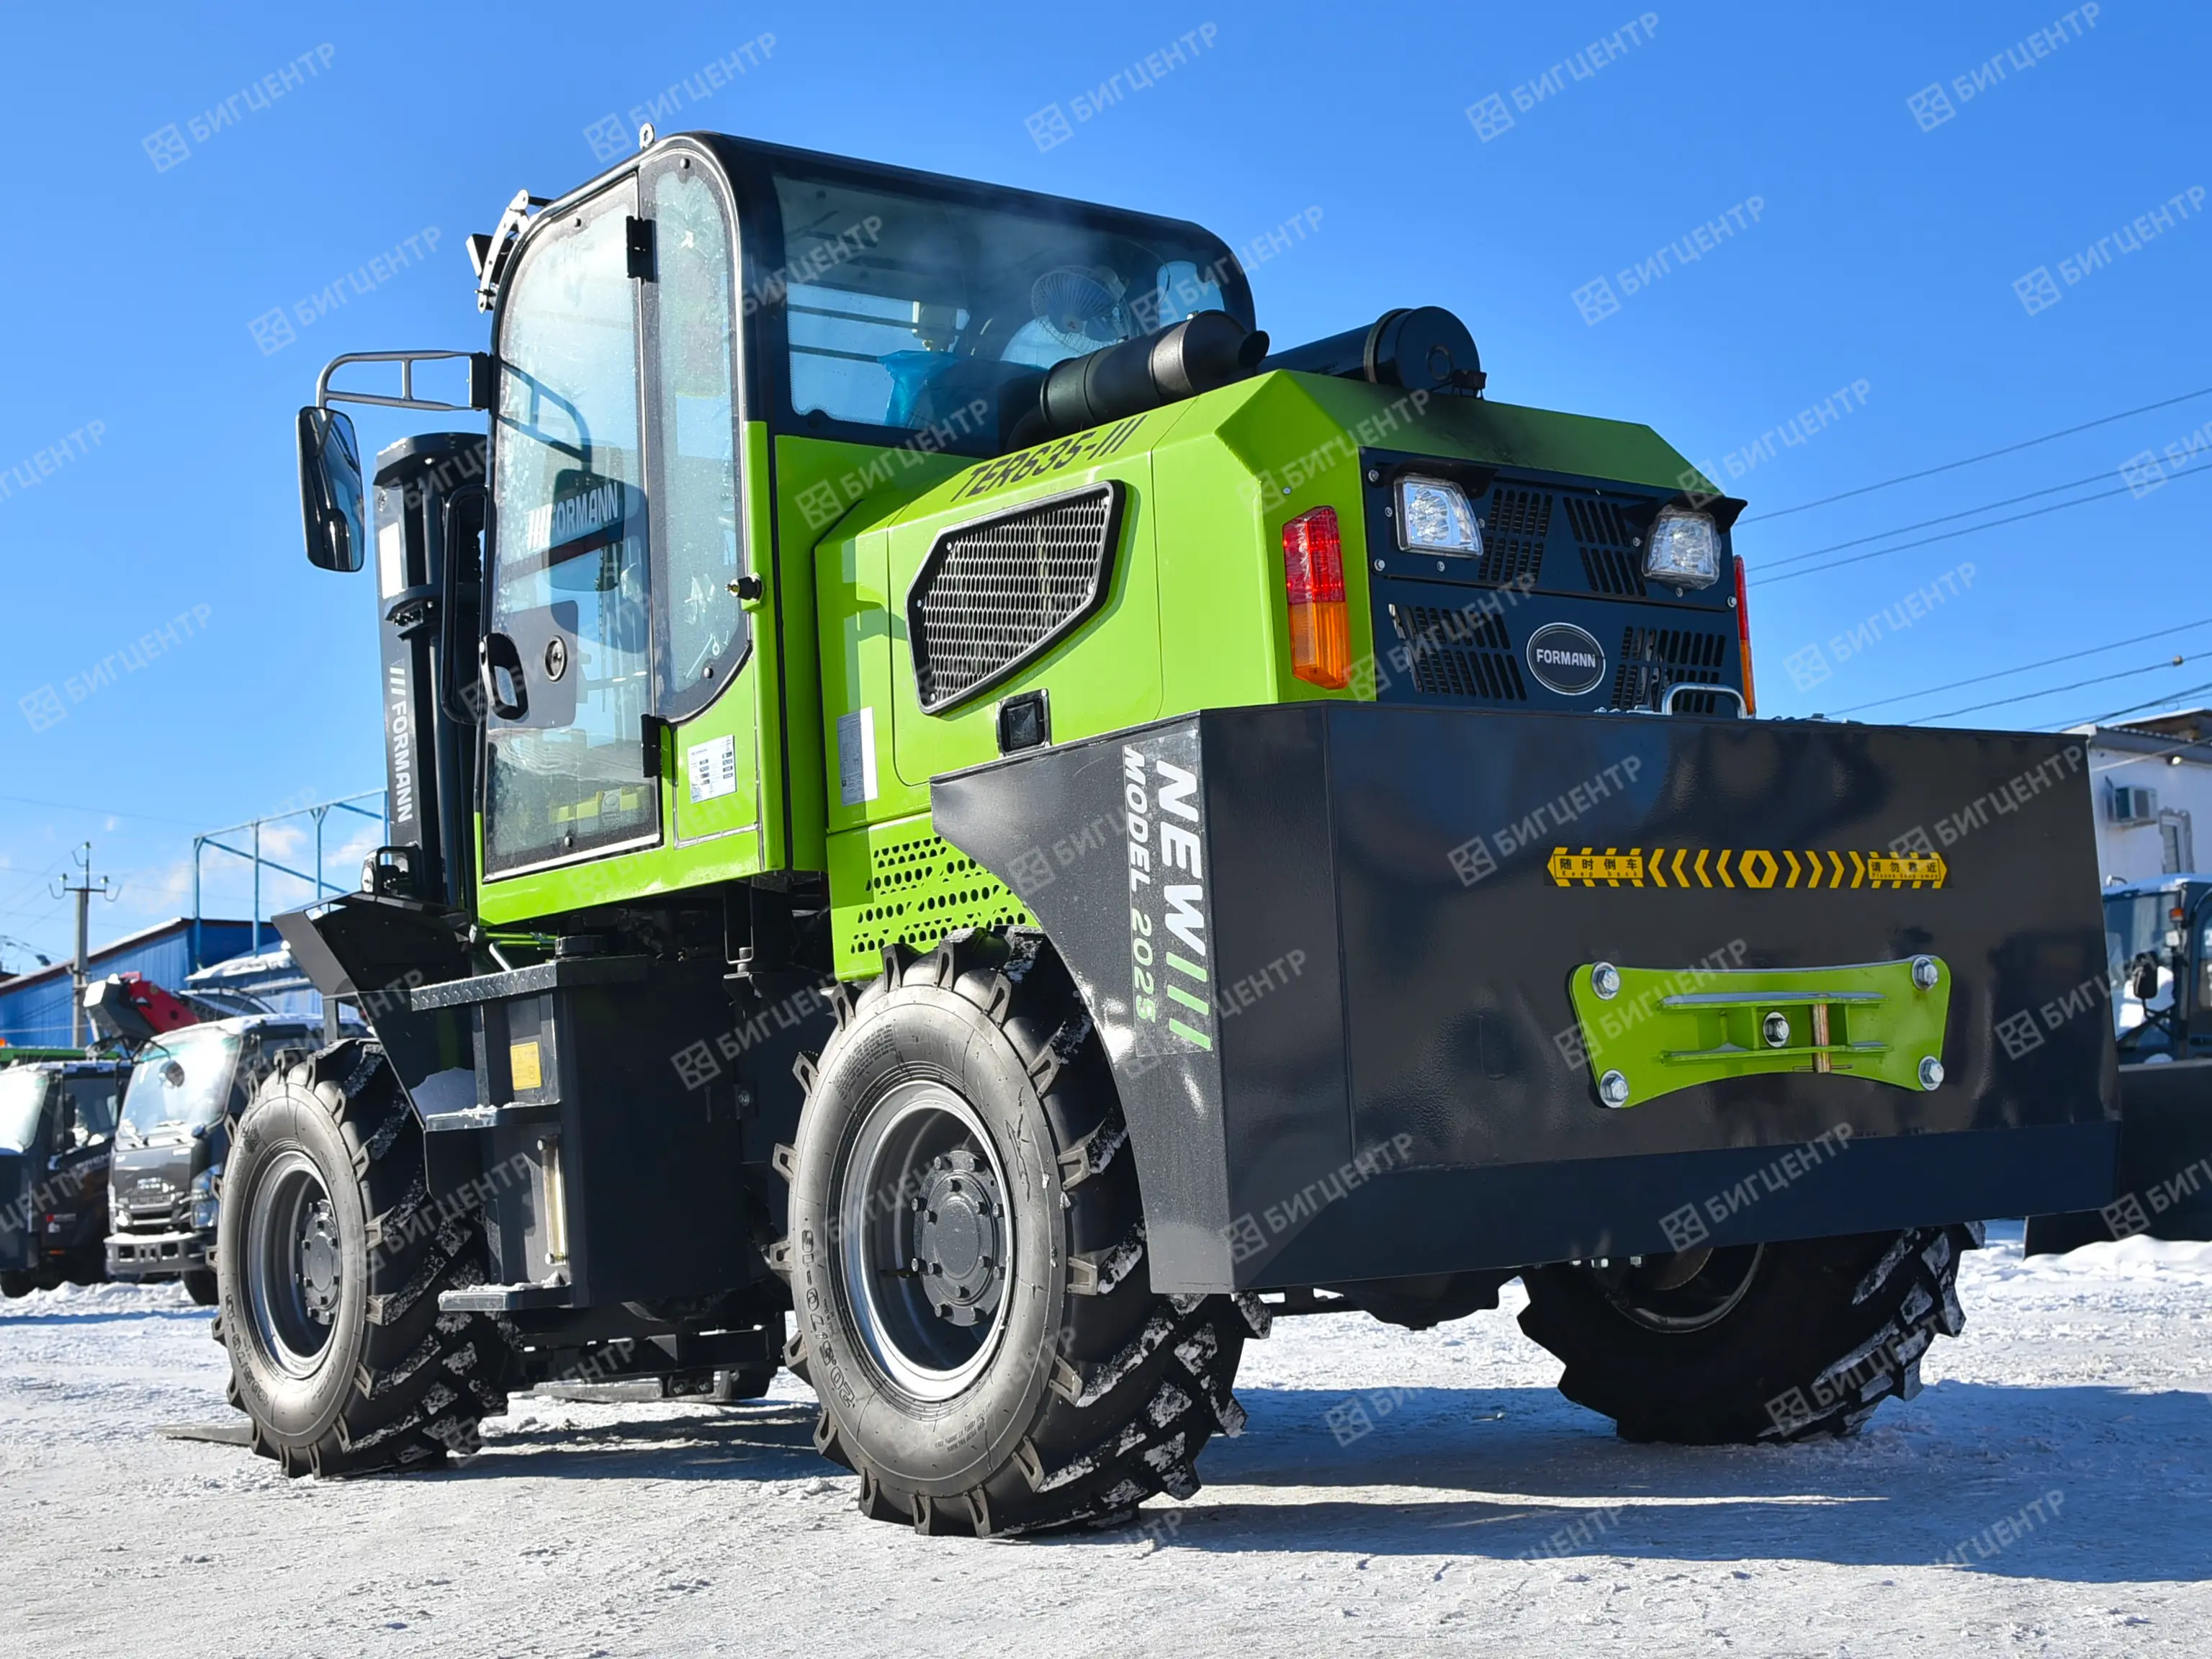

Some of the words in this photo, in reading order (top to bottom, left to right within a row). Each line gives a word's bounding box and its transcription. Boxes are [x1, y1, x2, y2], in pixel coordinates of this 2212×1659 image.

[1536, 648, 1596, 668] FORMANN
[392, 700, 413, 823] FORMANN
[1123, 745, 1151, 893] MODEL
[1559, 858, 1638, 871] 随时倒车
